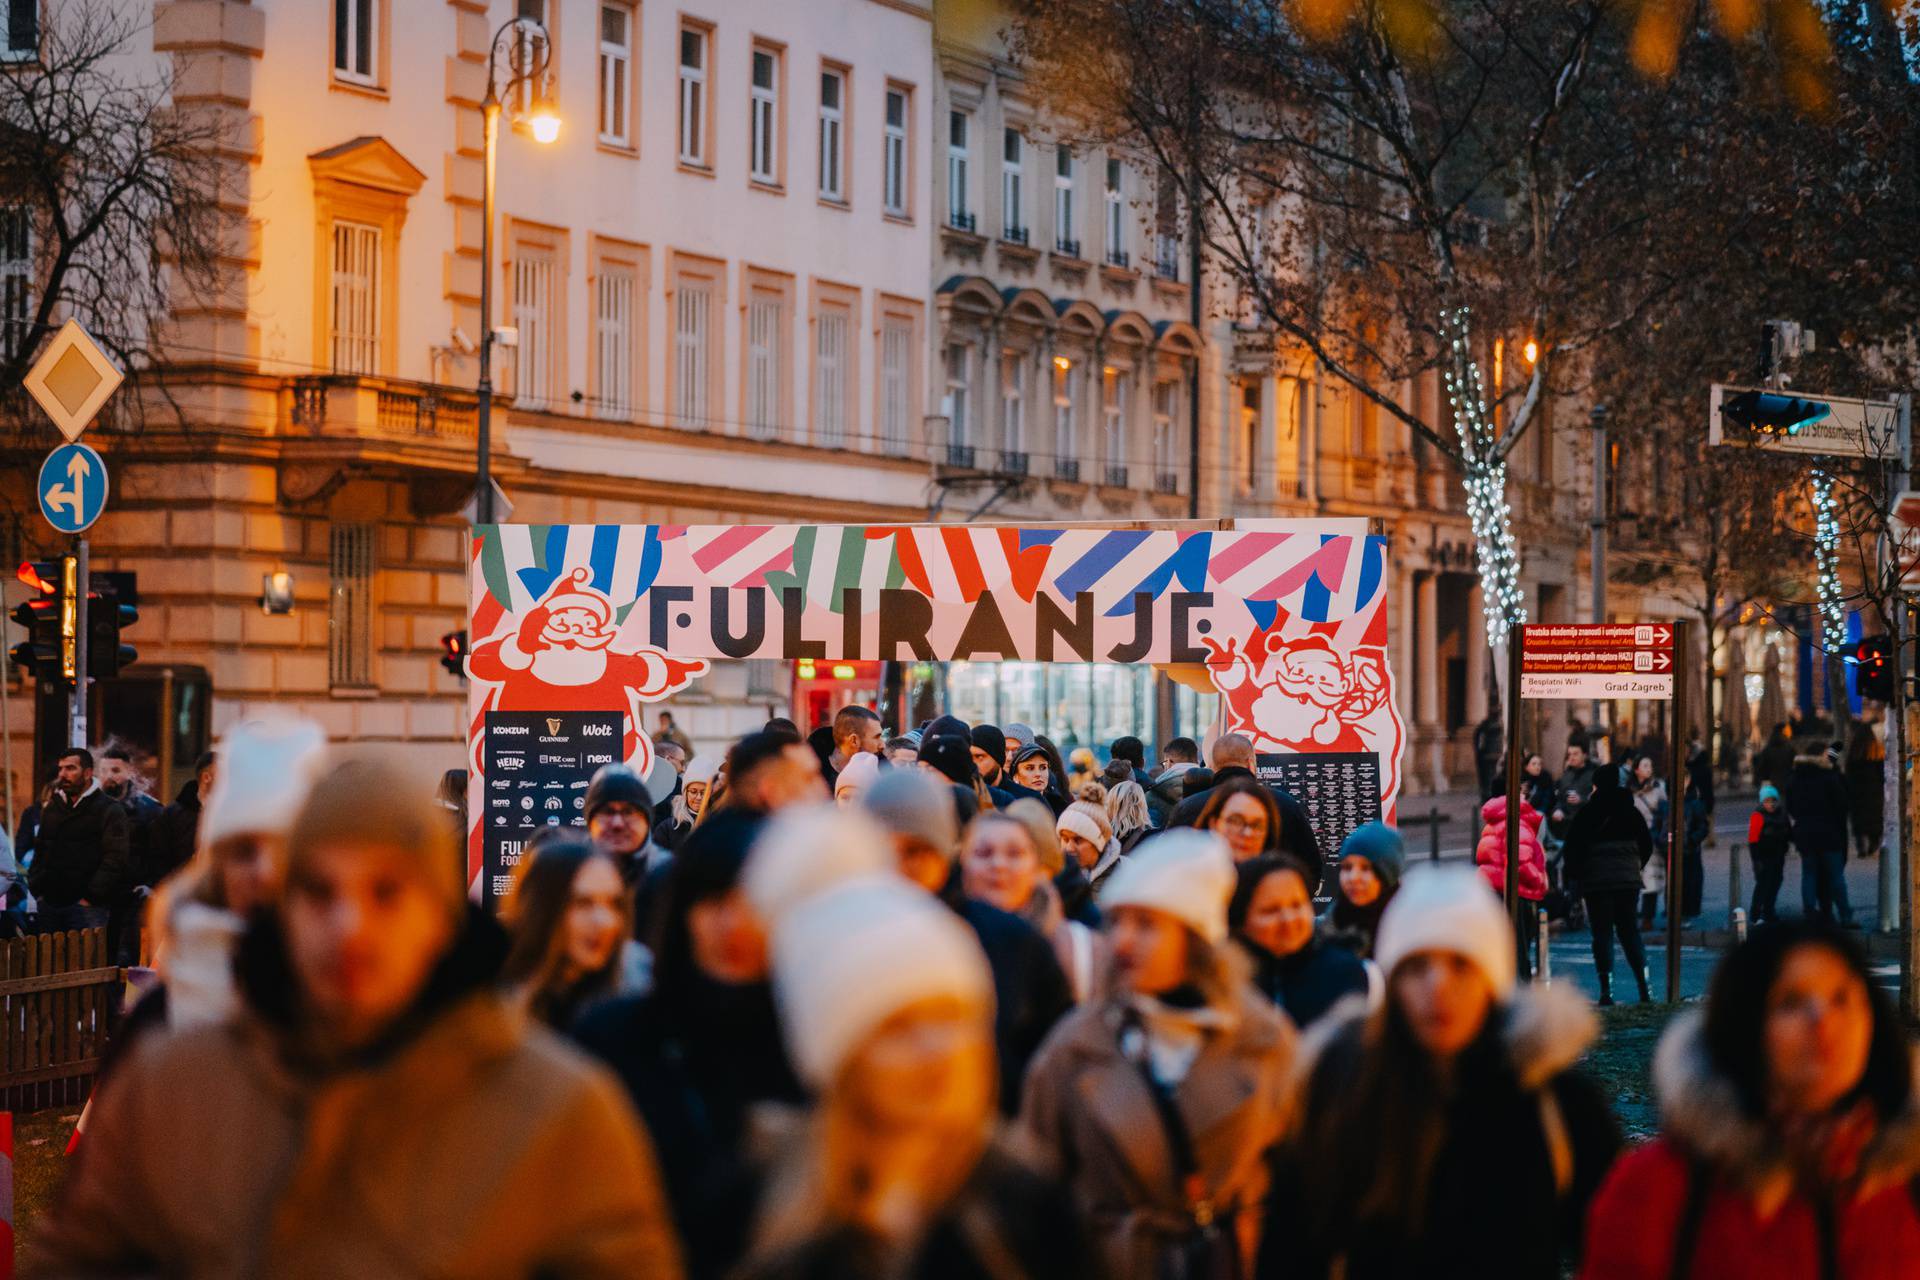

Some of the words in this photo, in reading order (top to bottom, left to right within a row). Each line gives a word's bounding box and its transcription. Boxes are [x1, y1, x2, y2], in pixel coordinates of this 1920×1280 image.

[650, 585, 1214, 663] FULIRANJE
[1526, 626, 1550, 637] Hrvatska
[1551, 626, 1577, 638] akademija
[1578, 626, 1602, 637] znanosti
[1605, 626, 1635, 638] umjetnosti
[1618, 651, 1633, 661] HAZU
[1528, 677, 1563, 687] Besplatni
[1565, 677, 1582, 686] WiFi
[1604, 681, 1628, 692] Grad
[1631, 682, 1666, 693] Zagreb
[1529, 687, 1544, 695] Free
[1546, 687, 1562, 695] WiFi
[493, 726, 529, 735] KONZUM
[582, 724, 613, 737] Wolt
[496, 757, 526, 769] HEINZ
[549, 755, 562, 763] PBZ
[587, 754, 612, 764] nexi
